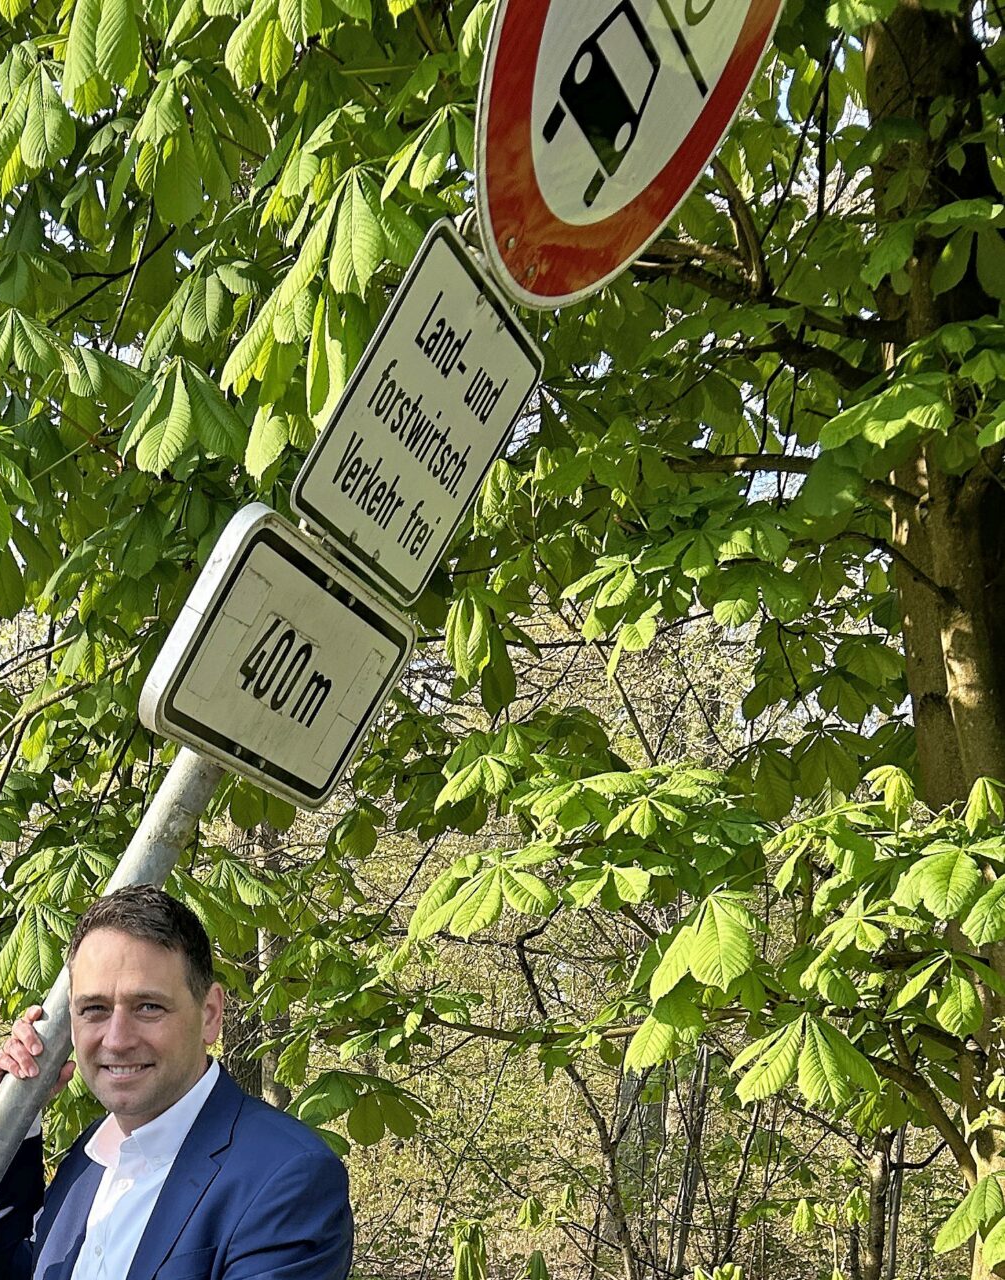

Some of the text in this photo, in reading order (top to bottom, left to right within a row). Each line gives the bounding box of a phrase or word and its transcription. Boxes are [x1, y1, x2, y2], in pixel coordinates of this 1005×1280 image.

[414, 290, 509, 425] Land- und
[367, 359, 472, 499] forstwirtsch.
[332, 431, 441, 560] Verkehr frei
[239, 617, 332, 728] 400 m
